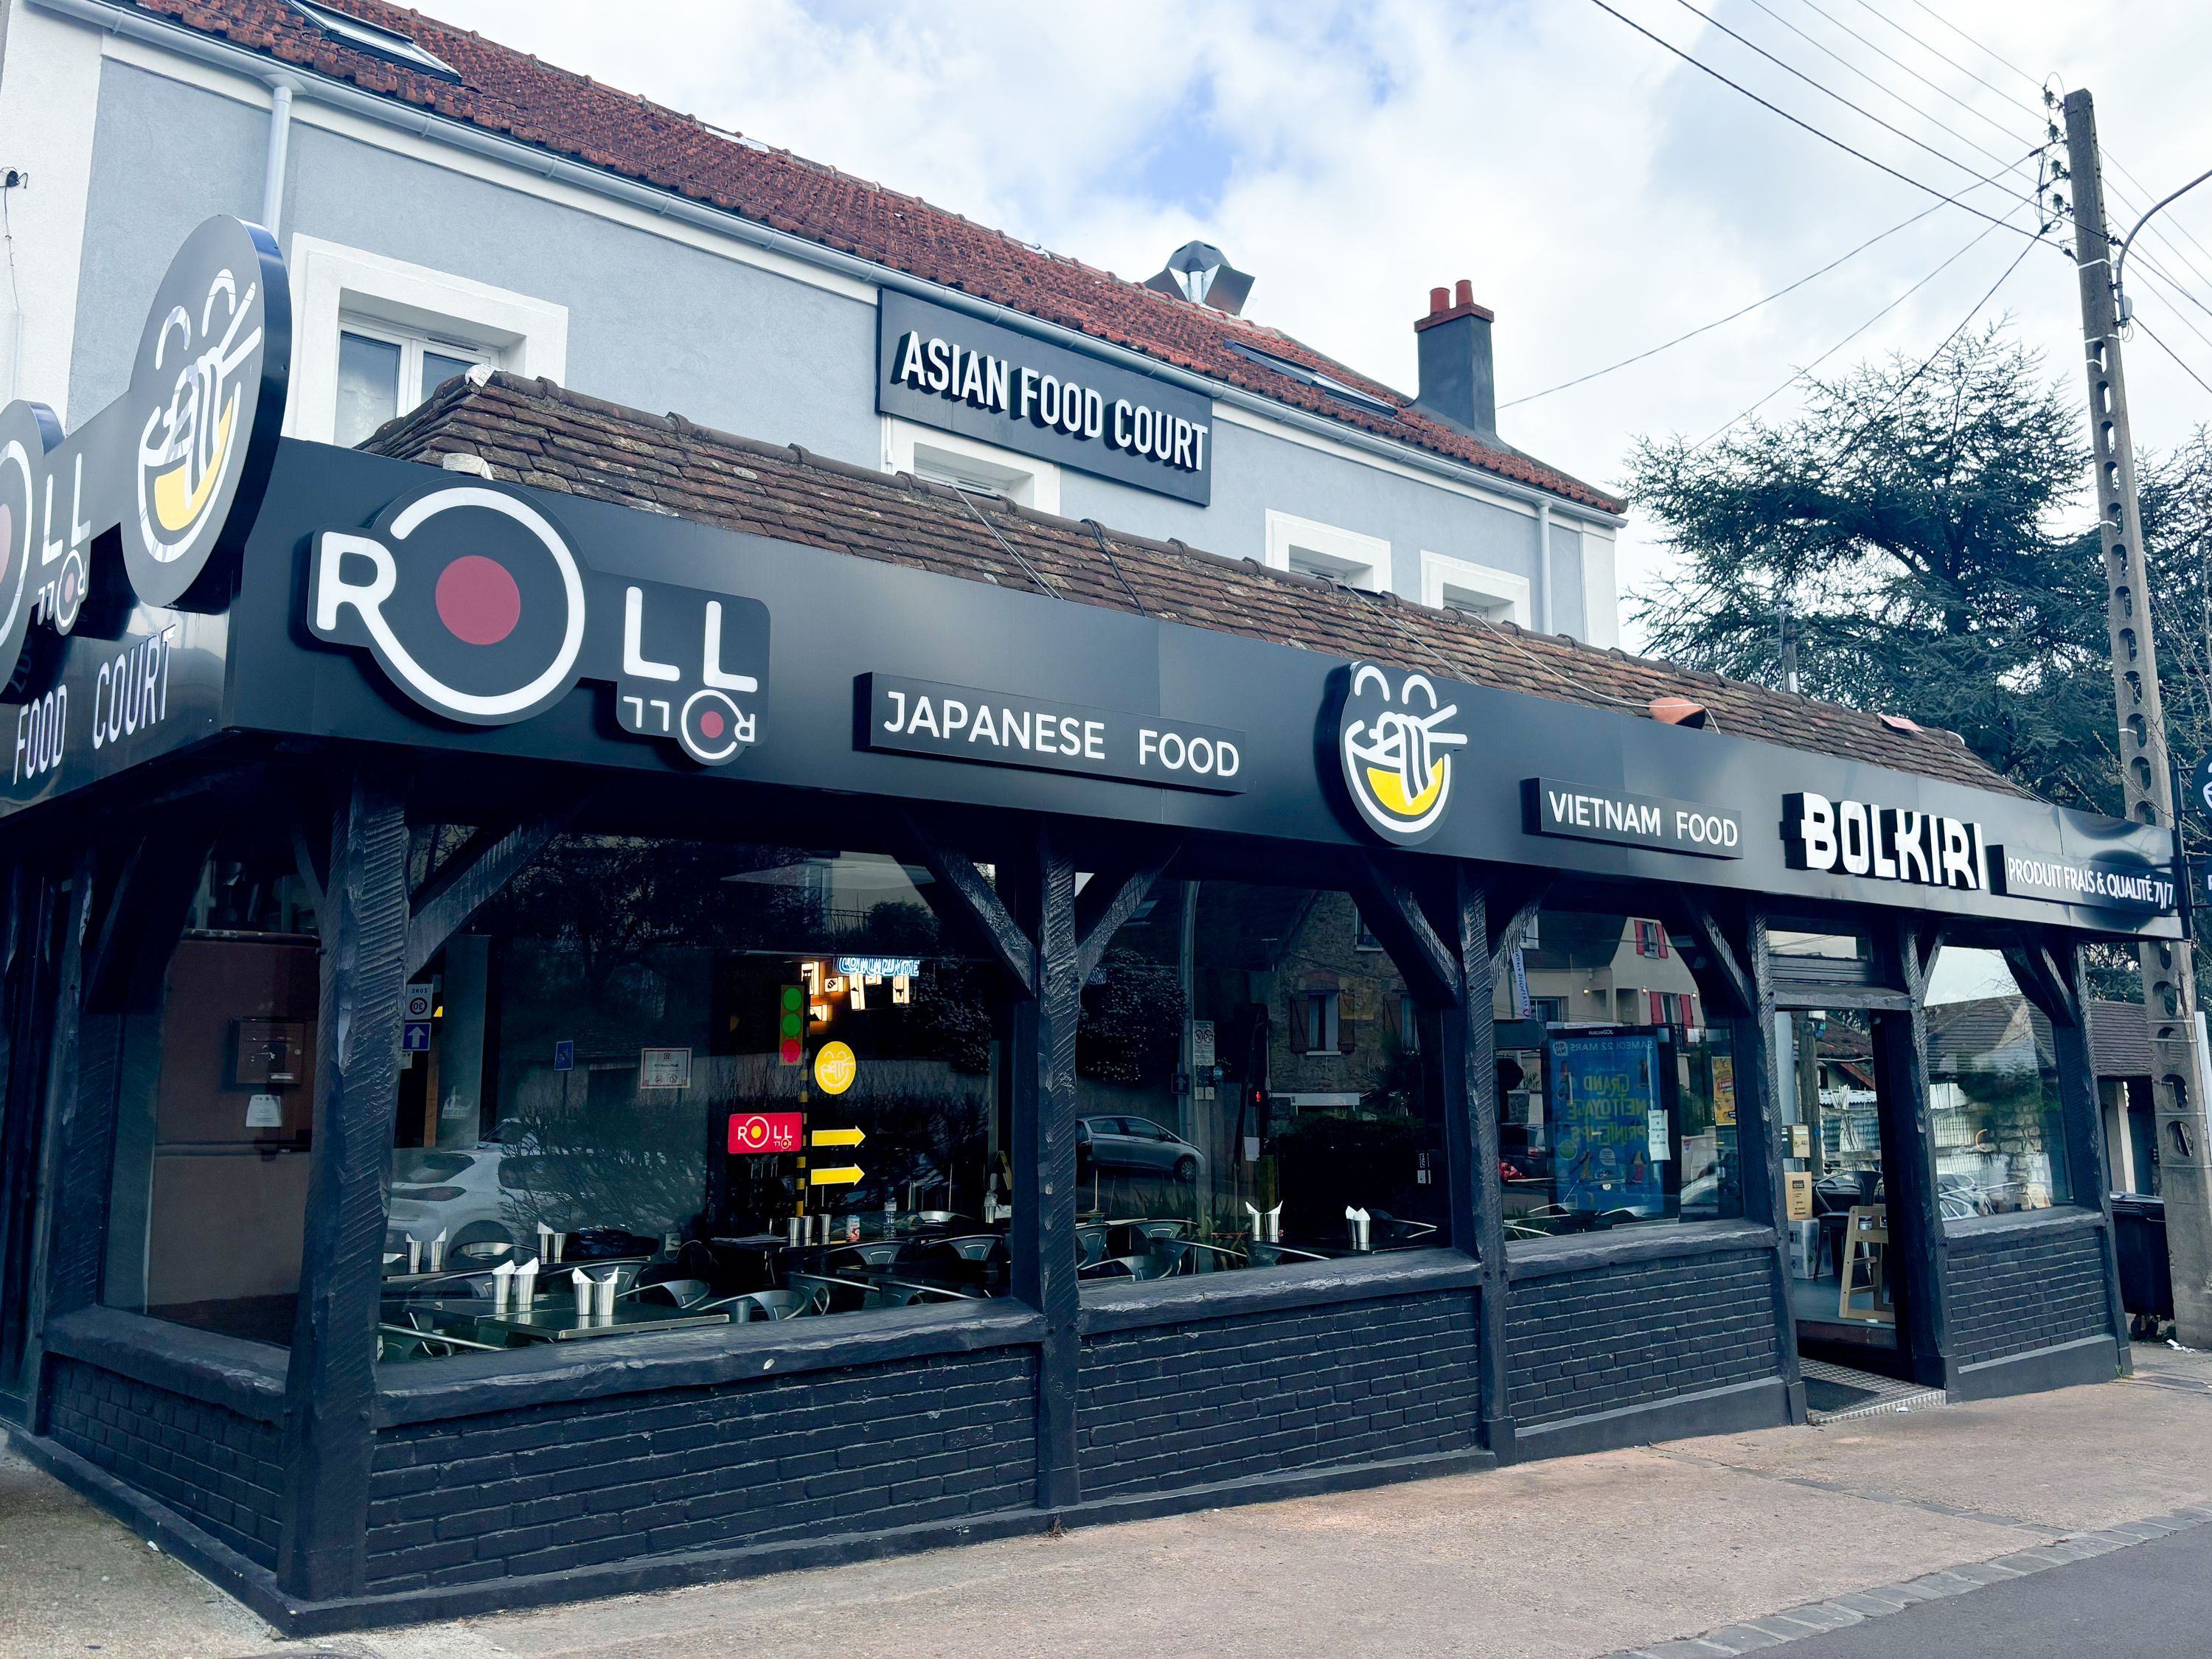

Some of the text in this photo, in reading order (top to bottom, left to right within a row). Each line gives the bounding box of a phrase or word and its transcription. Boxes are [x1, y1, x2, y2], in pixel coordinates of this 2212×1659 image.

[900, 330, 1208, 472] ASIAN FOOD COURT
[316, 487, 758, 715] ROLL
[13, 624, 176, 785] FOOD COURT
[883, 690, 1239, 777] JAPANESE FOOD
[1548, 790, 1738, 846] VIETNAM FOOD
[1801, 791, 1987, 890] BOLKIRI
[2007, 857, 2062, 888] PRODUIT
[2064, 866, 2096, 894] FRAIS
[2096, 872, 2107, 895] &
[2107, 873, 2154, 902] QUALITÉ
[737, 1116, 793, 1149] ROLL
